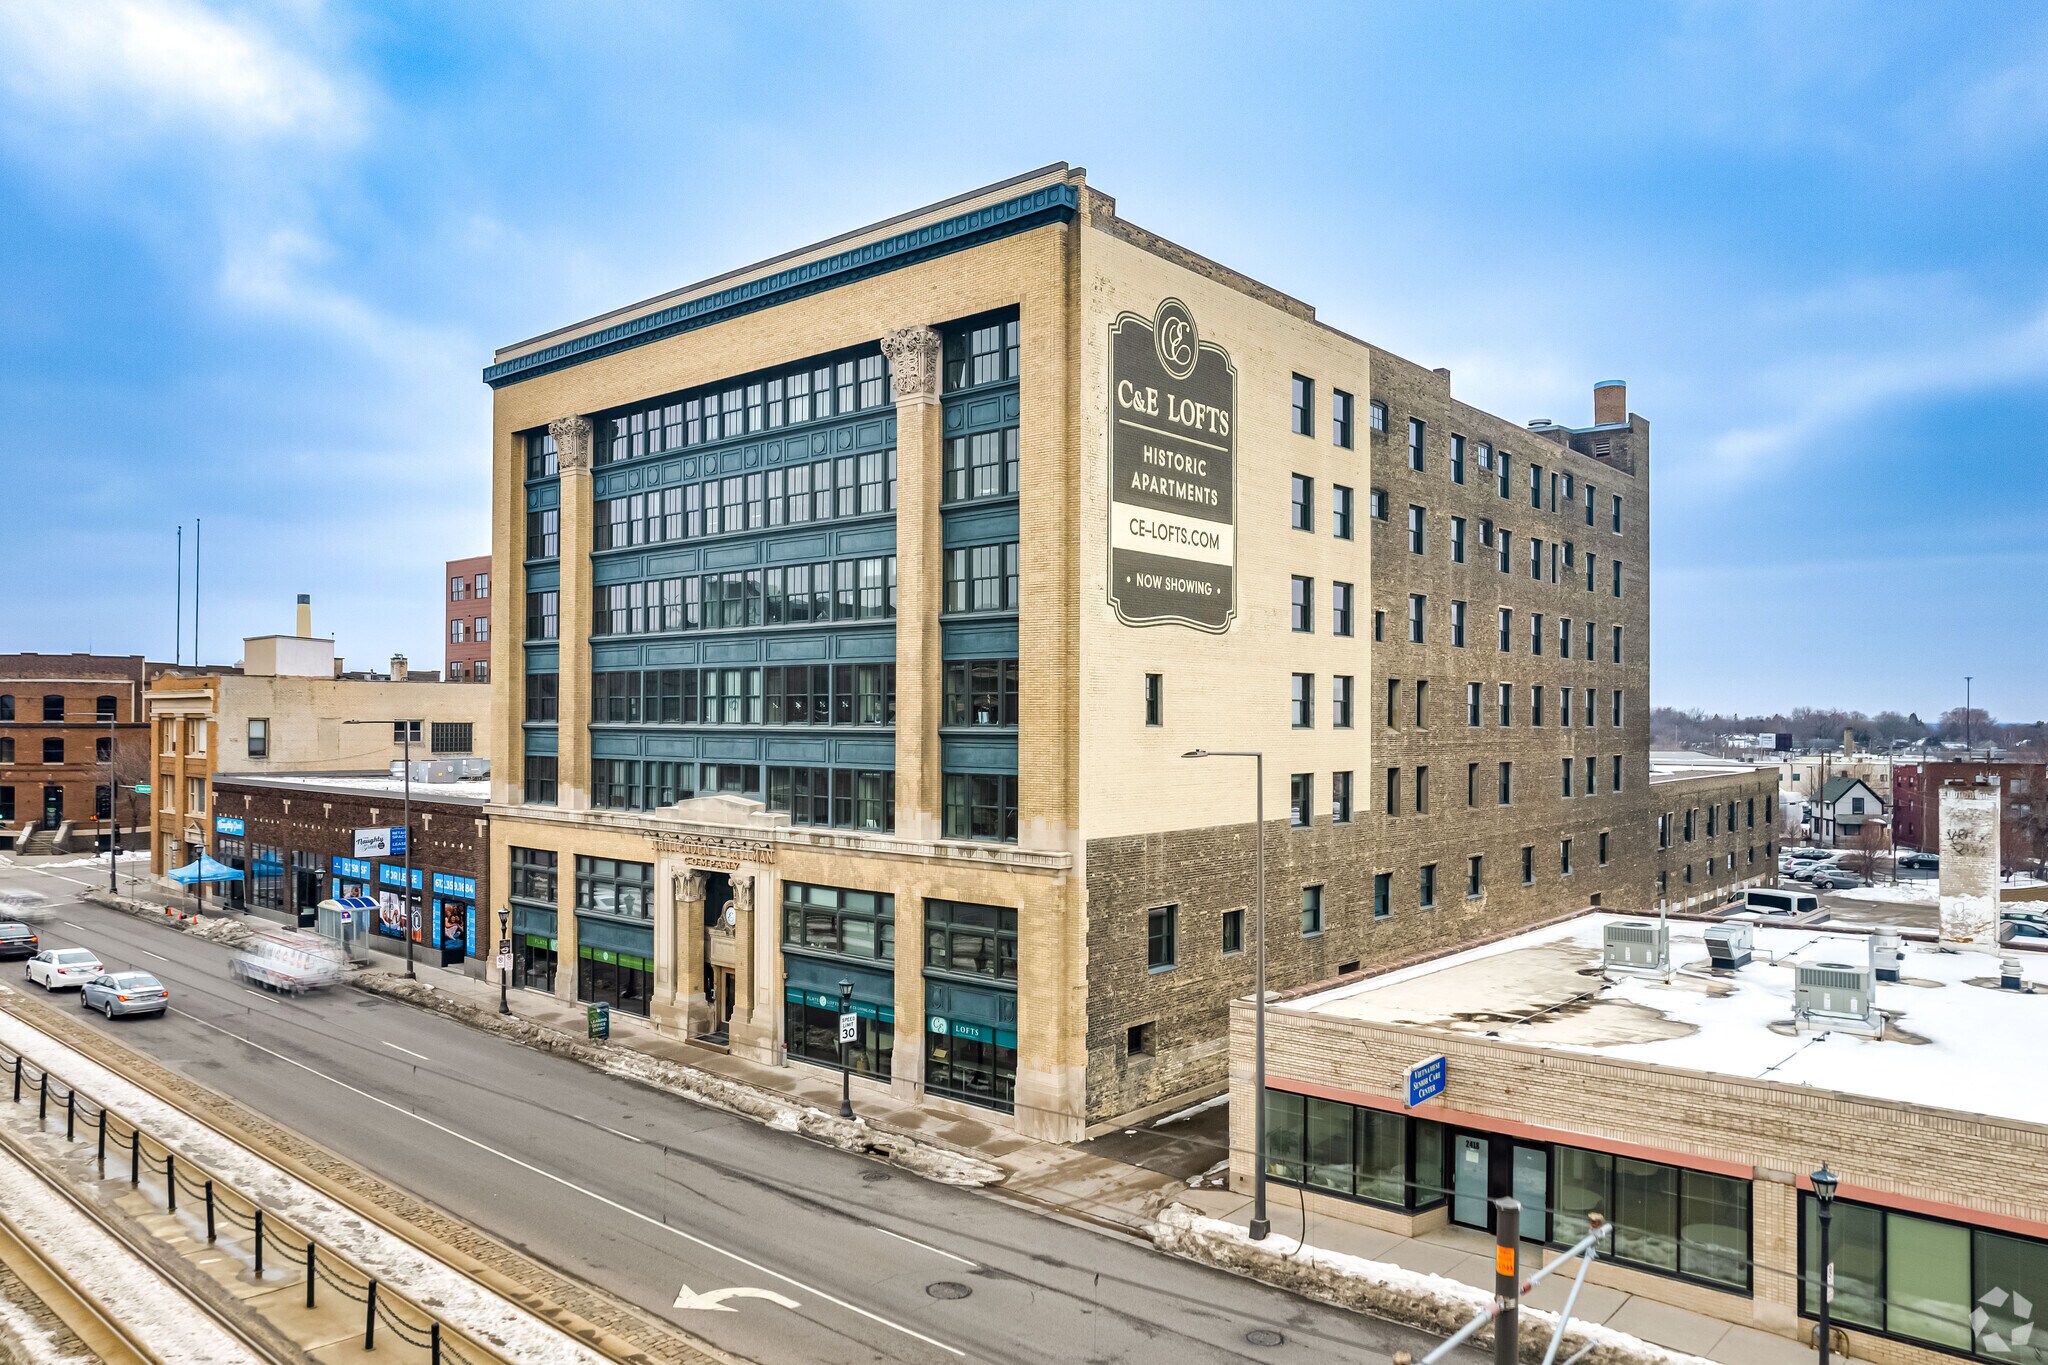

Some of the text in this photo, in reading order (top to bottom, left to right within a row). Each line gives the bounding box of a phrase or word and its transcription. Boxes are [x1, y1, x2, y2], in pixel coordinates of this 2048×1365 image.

[1117, 378, 1230, 437] C&E LOFTS
[1143, 445, 1208, 478] HISTORIC
[1131, 471, 1219, 507] APARTMENTS
[1129, 517, 1220, 551] CE-LOFTS.COM
[1136, 572, 1213, 597] NOW SHOWING
[684, 857, 740, 871] COMPANY
[842, 1028, 855, 1039] 30
[955, 1025, 979, 1036] LOFTS
[1414, 1062, 1441, 1079] VIETNAMESE
[1413, 1072, 1441, 1091] SENIOR CARE
[1418, 1084, 1436, 1098] CENTER
[1465, 1140, 1480, 1149] 2418
